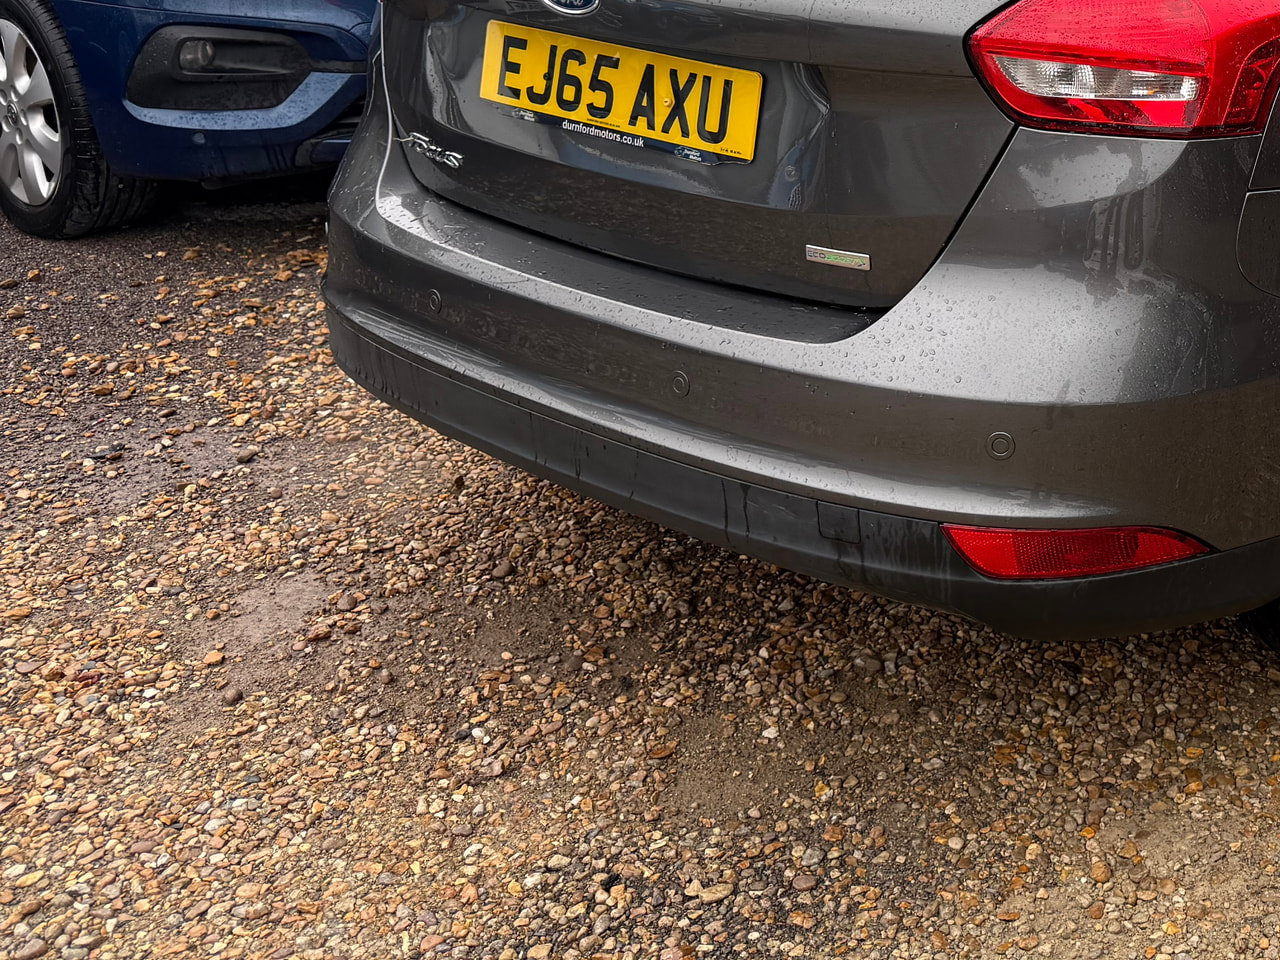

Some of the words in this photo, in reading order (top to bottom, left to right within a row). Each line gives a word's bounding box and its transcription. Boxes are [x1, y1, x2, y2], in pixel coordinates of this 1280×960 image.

[499, 35, 620, 119] EJ65
[628, 64, 733, 144] AXU
[562, 119, 645, 148] durnfordmotors.co.uk
